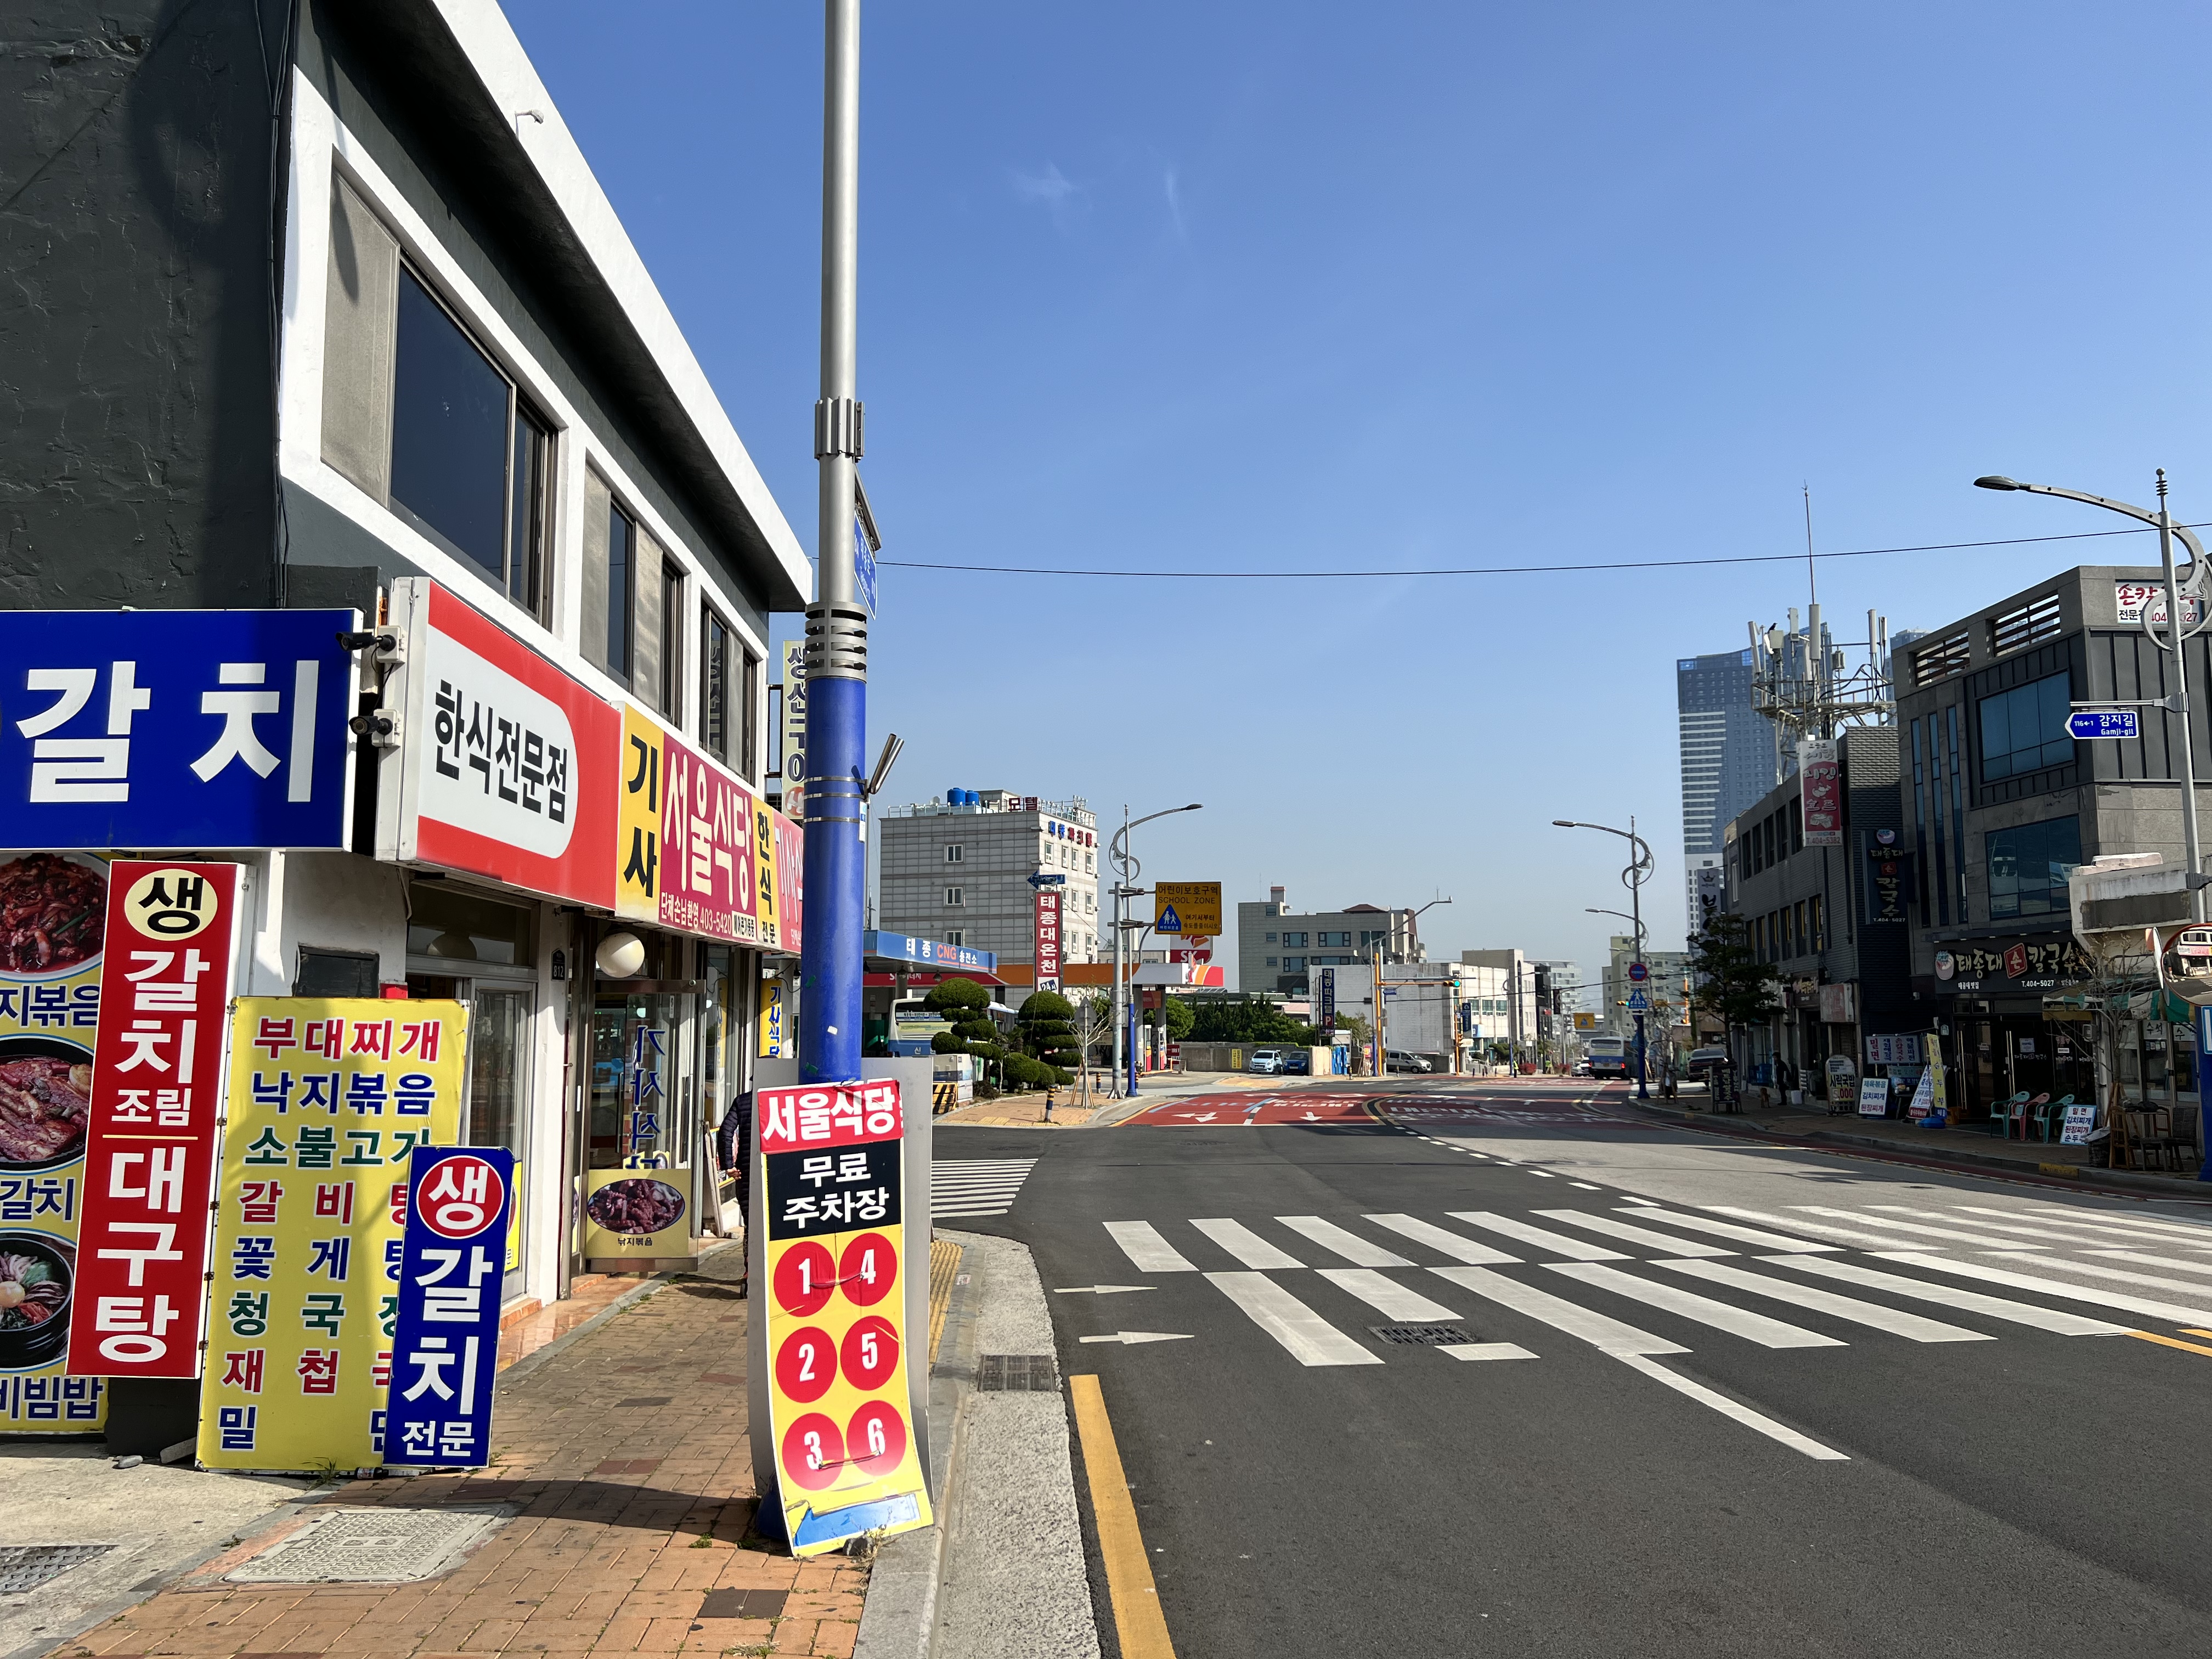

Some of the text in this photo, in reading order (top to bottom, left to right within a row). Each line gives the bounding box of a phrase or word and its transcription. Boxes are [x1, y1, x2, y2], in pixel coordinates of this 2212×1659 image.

[2119, 610, 2142, 620] 전문
[16, 660, 319, 802] 갈치
[2099, 714, 2134, 727] 감지길
[2101, 728, 2134, 736] Gamji-gil
[435, 679, 568, 825] 한식전문점
[623, 733, 658, 898] 기사
[1008, 797, 1037, 812] 모텔
[1805, 799, 1837, 811] 호프
[664, 751, 752, 911] 서울식당
[757, 811, 773, 916] 한식
[1870, 847, 1903, 859] 태종대
[139, 877, 204, 934] 생
[1159, 885, 1218, 895] 어린이보호구역
[1876, 877, 1900, 917] 칼국수
[700, 906, 732, 935] 403-5420
[762, 921, 776, 944] 전문
[1040, 895, 1057, 974] 태종대온천
[906, 938, 978, 965] 태종 CNG 충전소
[1956, 941, 2076, 979] 태종대 손 칼국수
[554, 965, 563, 978] 812
[2021, 980, 2055, 988] T.404-5027
[114, 949, 210, 1084] 갈치
[1325, 1016, 1331, 1026] P
[2147, 1022, 2163, 1035] 수석
[253, 1016, 441, 1063] 부대찌개
[1870, 1038, 1880, 1062] 밀면
[252, 1071, 436, 1115] 낙지볶음
[1830, 1074, 1855, 1087] 시락국밥
[1864, 1080, 1887, 1088] 제육볶음
[111, 1088, 192, 1126] 조림
[763, 1089, 897, 1143] 서울식당
[245, 1126, 430, 1168] 소불고기
[800, 1153, 871, 1188] 무료
[0, 1178, 74, 1221] 갈치
[428, 1166, 487, 1231] 생
[783, 1187, 890, 1229] 주차장
[95, 1147, 187, 1363] 대구탕
[798, 1249, 877, 1295] 1 4
[402, 1246, 494, 1417] 갈치
[799, 1333, 878, 1382] 2 5
[401, 1420, 475, 1458] 전문
[804, 1418, 885, 1470] 3 6
